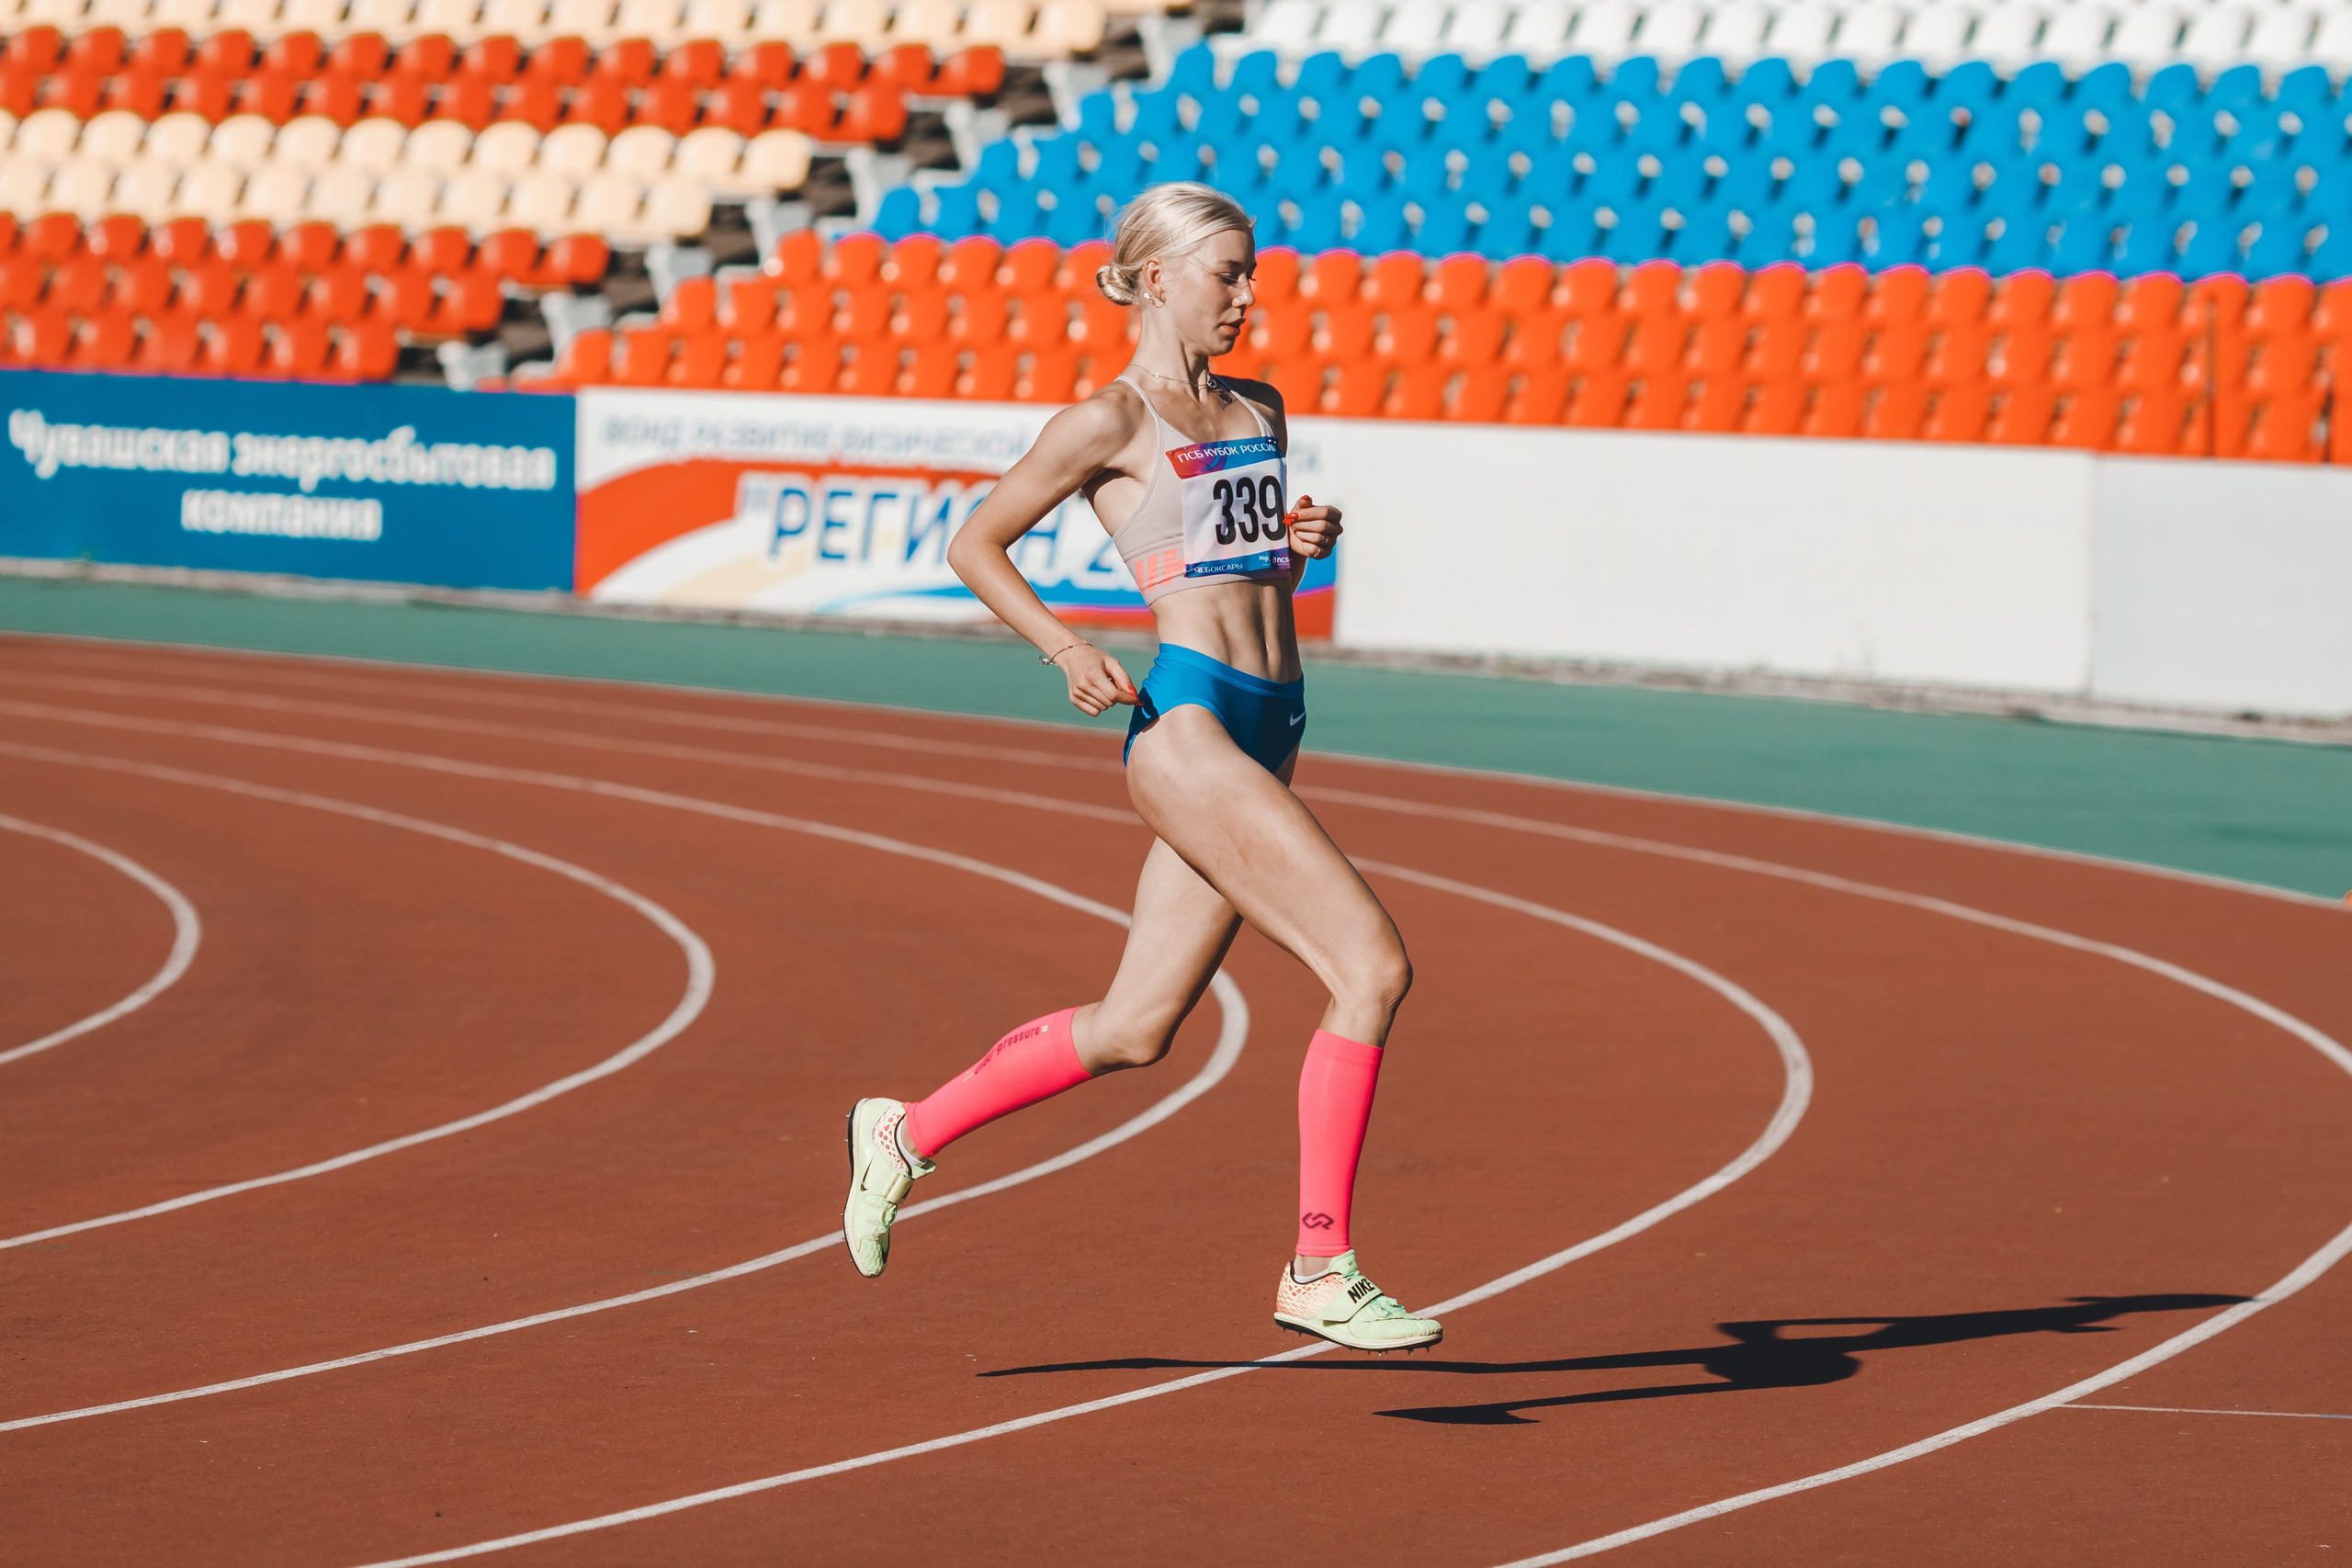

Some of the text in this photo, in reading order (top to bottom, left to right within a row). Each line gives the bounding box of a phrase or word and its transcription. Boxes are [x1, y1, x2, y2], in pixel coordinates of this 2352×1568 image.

[9, 410, 556, 491] Чувашская энергосбытовая
[1177, 449, 1204, 463] ПСБ
[1204, 446, 1238, 457] КУБОК
[181, 489, 382, 541] компания
[1213, 475, 1286, 545] 339
[997, 1026, 1040, 1055] pressure
[1347, 1278, 1375, 1303] NIKE
